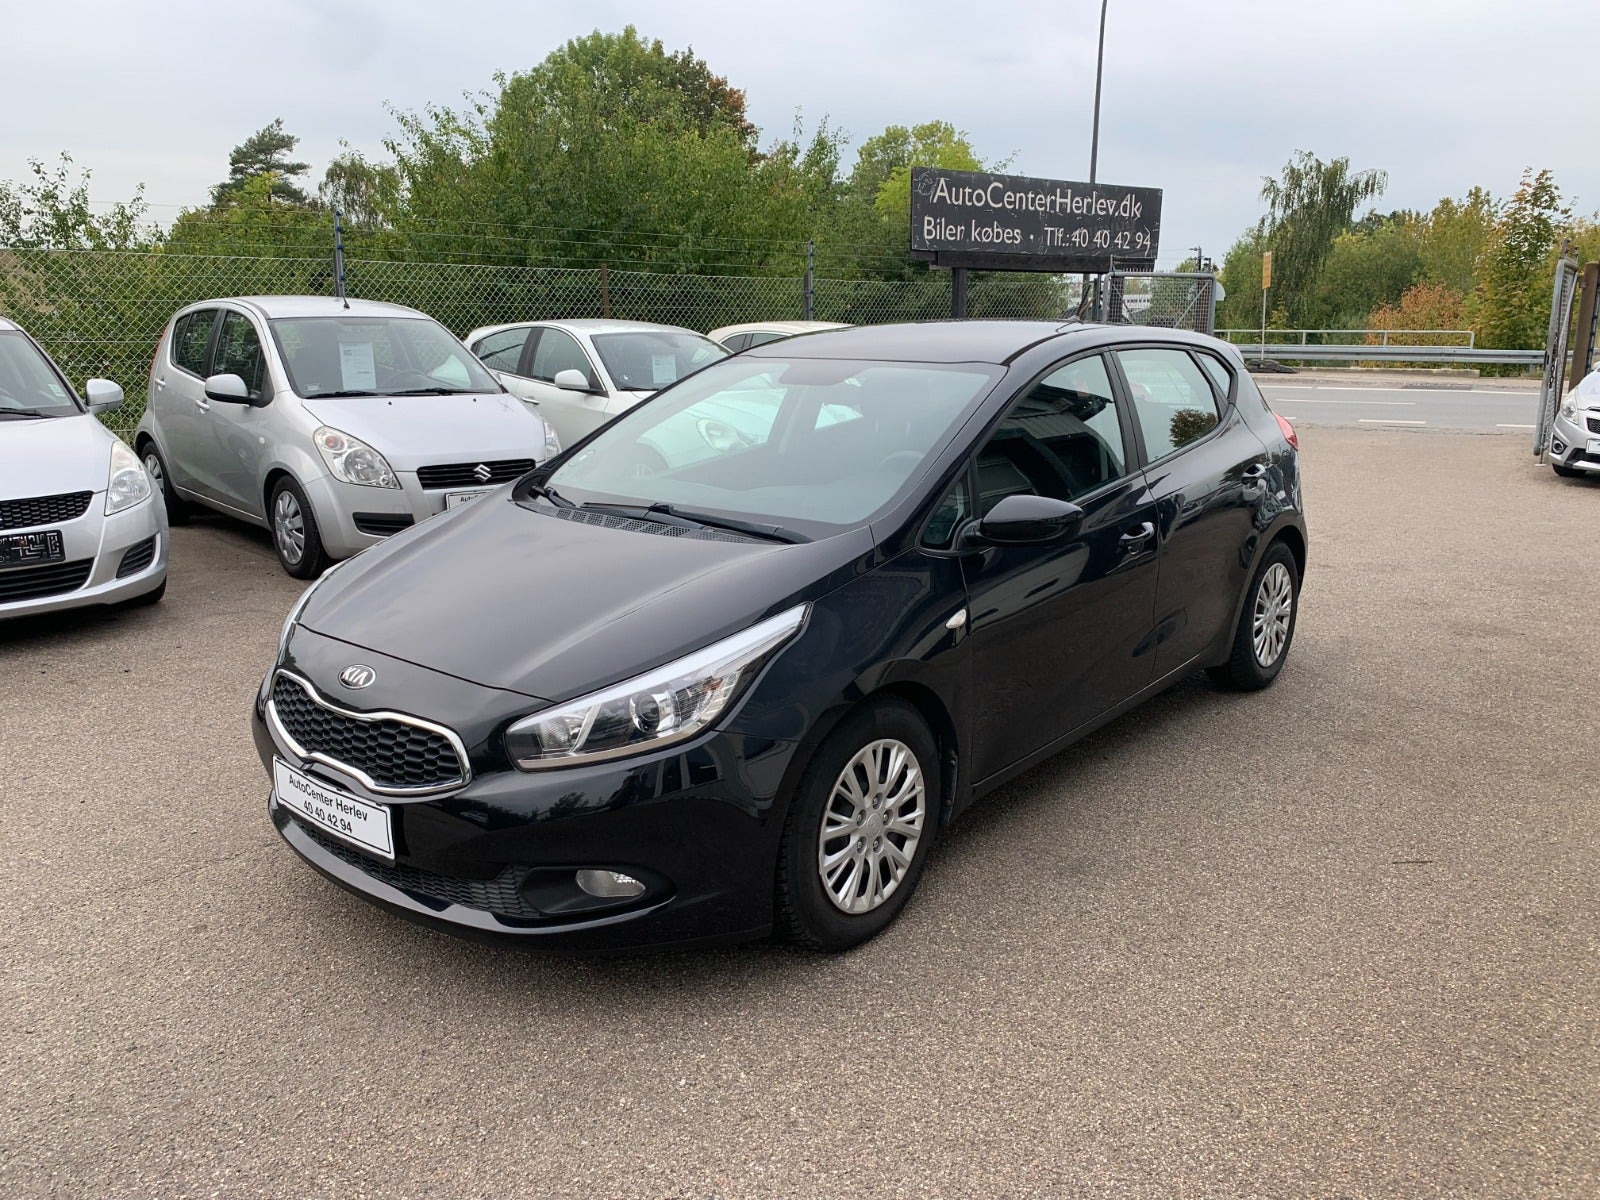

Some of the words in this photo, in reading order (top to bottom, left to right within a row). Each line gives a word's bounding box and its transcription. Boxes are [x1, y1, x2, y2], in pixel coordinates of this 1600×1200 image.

[933, 177, 1142, 218] AutoCenterHerlev.dk
[924, 215, 965, 241] Biler
[971, 219, 1021, 244] købes
[1093, 229, 1110, 249] 40
[1114, 231, 1131, 250] 42
[1135, 231, 1152, 252] 94
[341, 667, 368, 685] KIA
[289, 774, 333, 807] AutoCenter
[336, 798, 368, 822] Herlev
[304, 800, 313, 814] 40
[315, 807, 325, 821] 40
[327, 813, 339, 828] 42
[340, 818, 352, 833] 94
